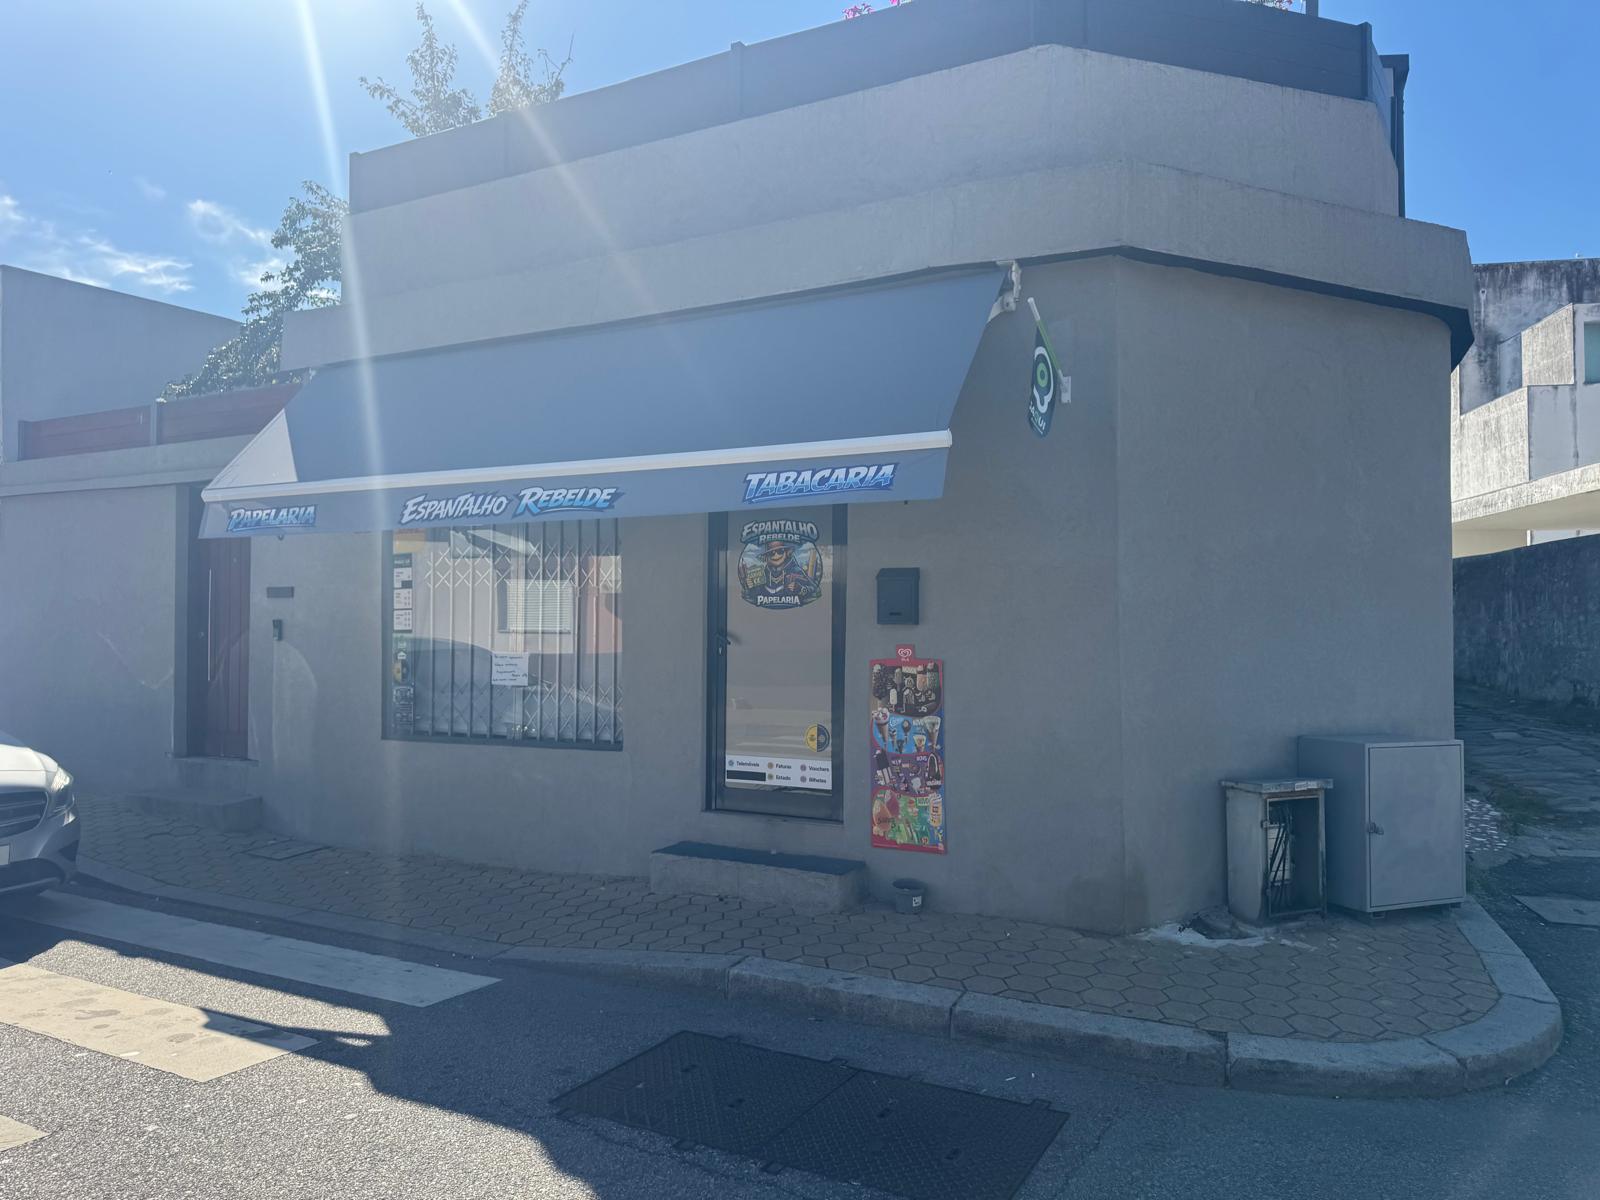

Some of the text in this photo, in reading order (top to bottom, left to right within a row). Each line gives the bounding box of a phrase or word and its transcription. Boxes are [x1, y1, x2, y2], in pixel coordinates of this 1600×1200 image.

[744, 464, 896, 500] TABACARIA
[401, 487, 617, 524] ESPANTALHO REBELDE
[227, 505, 316, 531] PAPELARIA
[742, 519, 818, 540] ESPANTALHO
[758, 533, 801, 544] REBELDE
[757, 595, 801, 606] PAPELARIA
